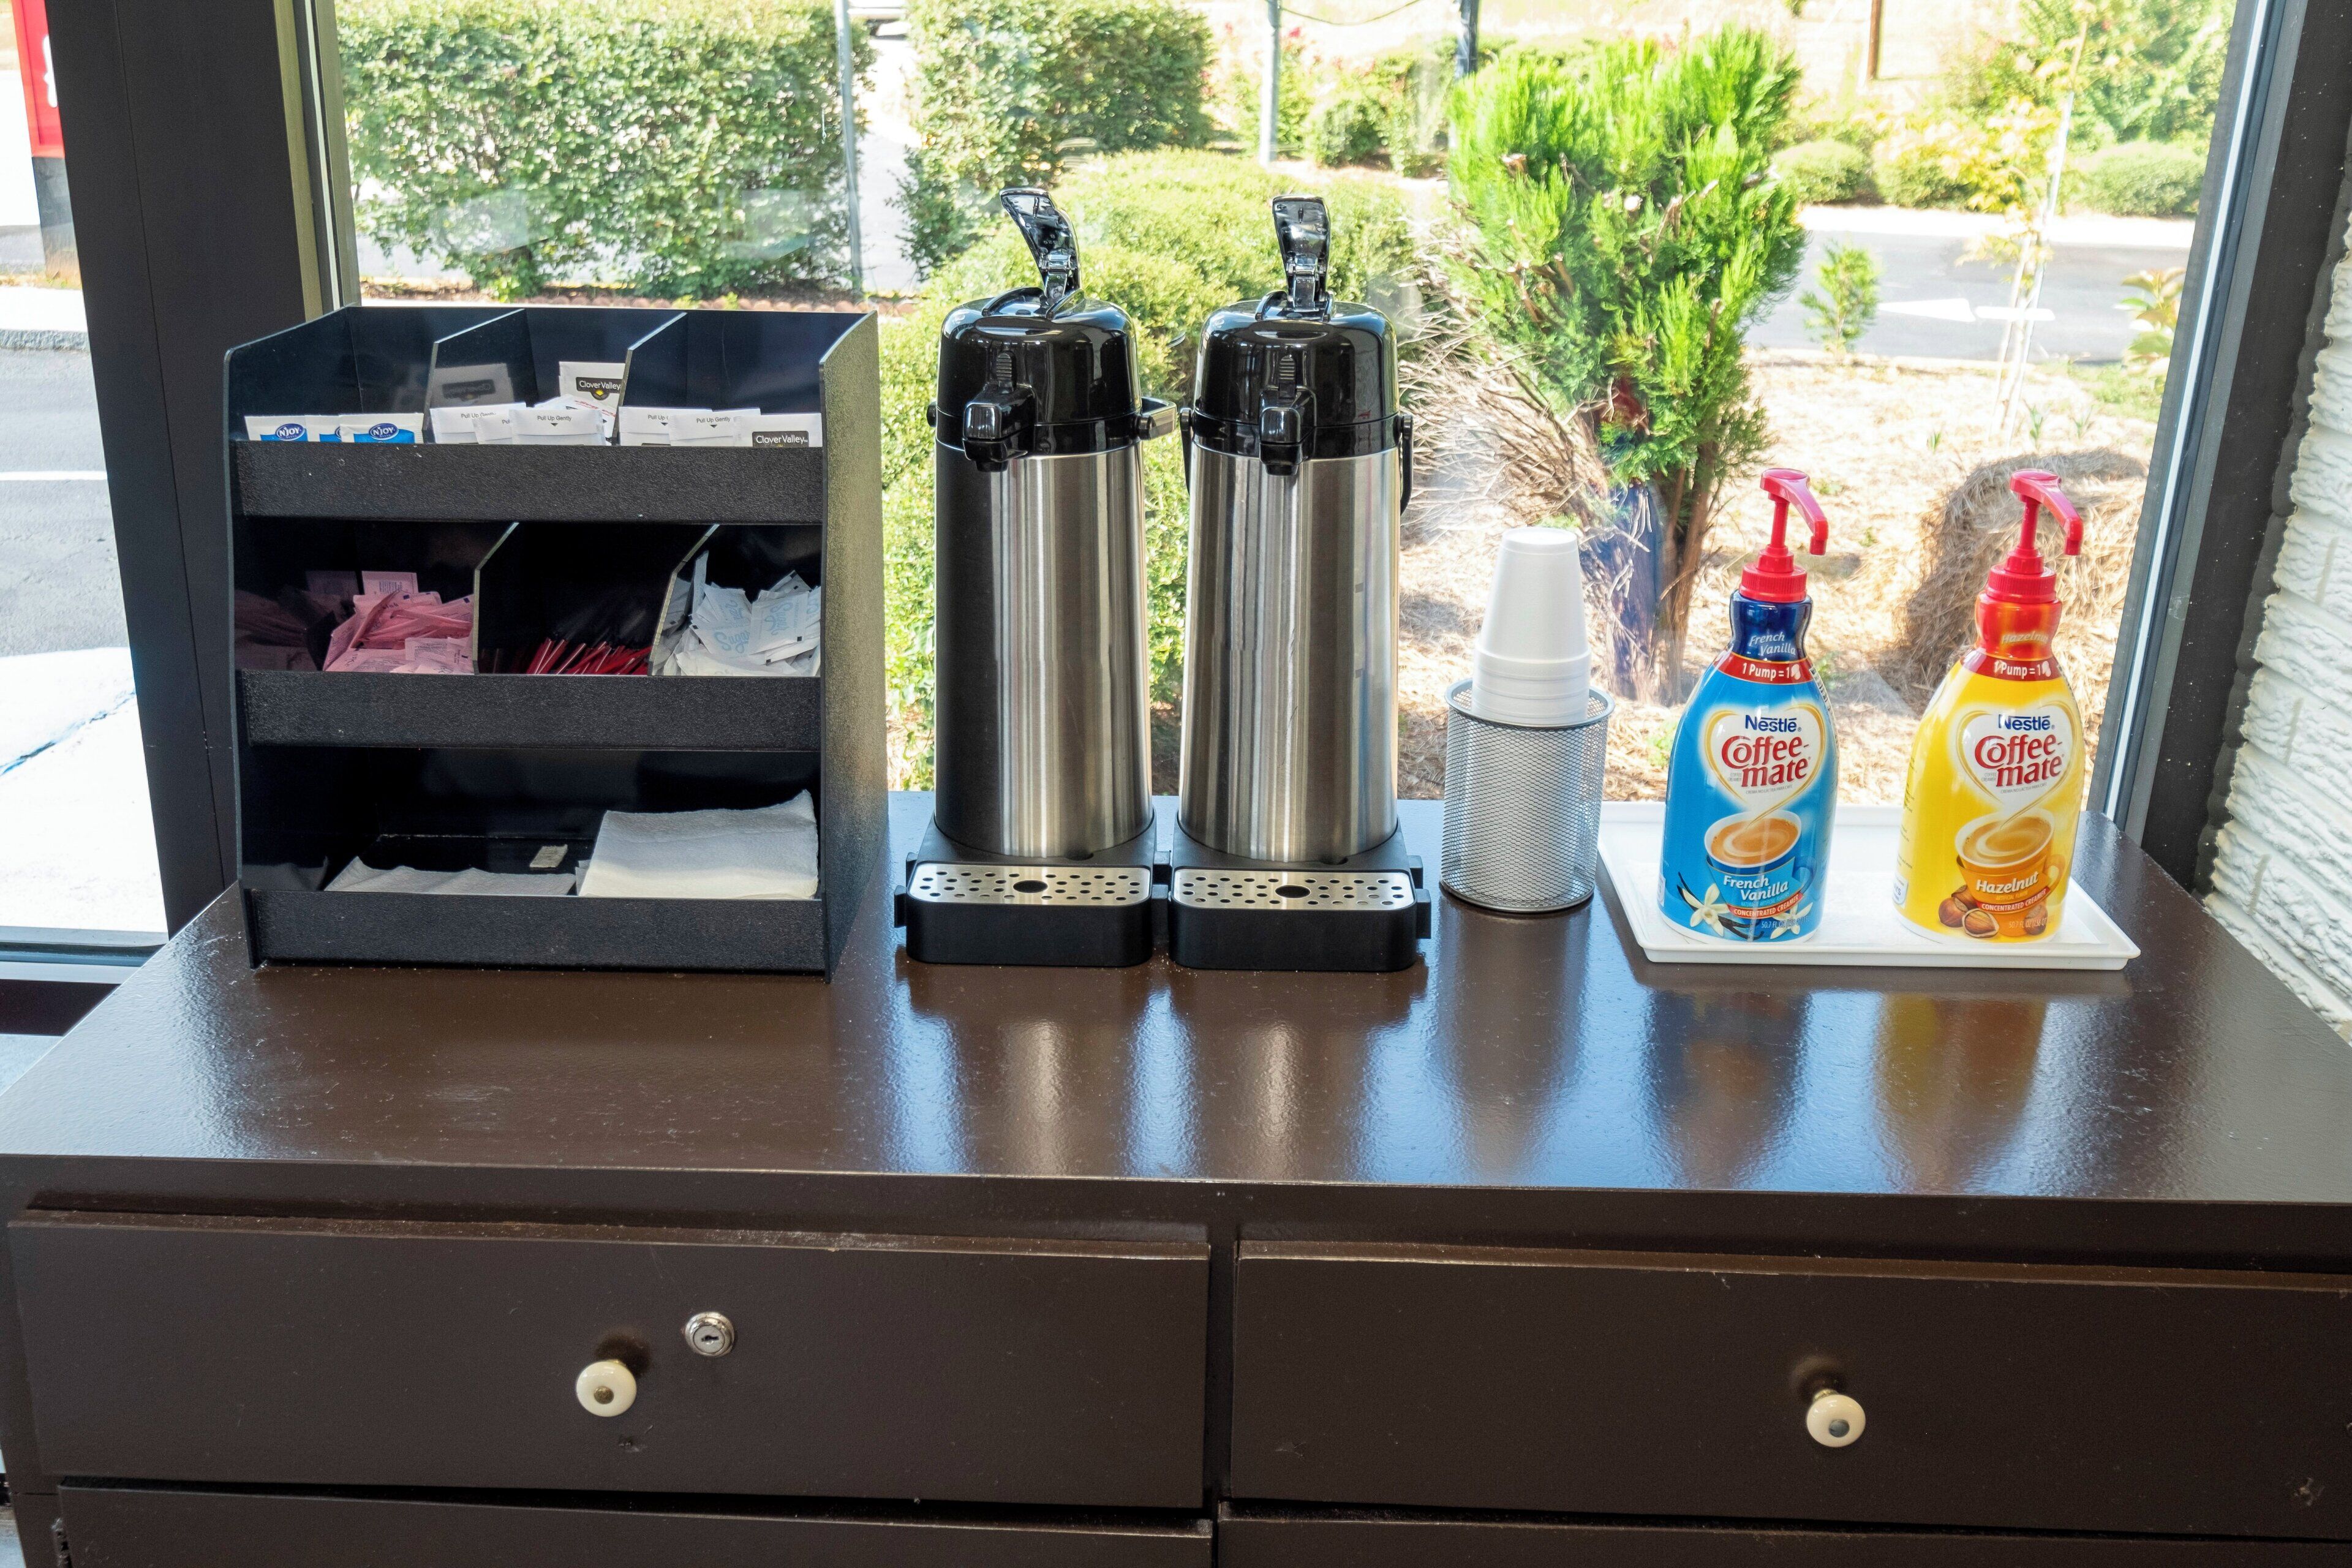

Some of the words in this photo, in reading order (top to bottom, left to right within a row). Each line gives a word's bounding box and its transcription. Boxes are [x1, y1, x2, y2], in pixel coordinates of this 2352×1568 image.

[1749, 631, 1785, 647] French
[1760, 643, 1796, 657] Vanilla
[1743, 662, 1747, 674] 1
[1749, 663, 1776, 682] Pump
[1786, 666, 1790, 679] 1
[2000, 661, 2027, 679] Pump
[2037, 664, 2041, 676] 1
[1741, 758, 1809, 787] mate
[1996, 755, 2062, 787] mate
[1723, 875, 1770, 889] French
[1741, 881, 1789, 901] Vanilla
[1976, 871, 2039, 894] Hazelnut
[1733, 907, 1776, 918] CONCENTRATED
[1777, 894, 1800, 913] CREAMER
[1981, 902, 2024, 911] CONCENTRATED
[2024, 888, 2046, 907] CREAMER
